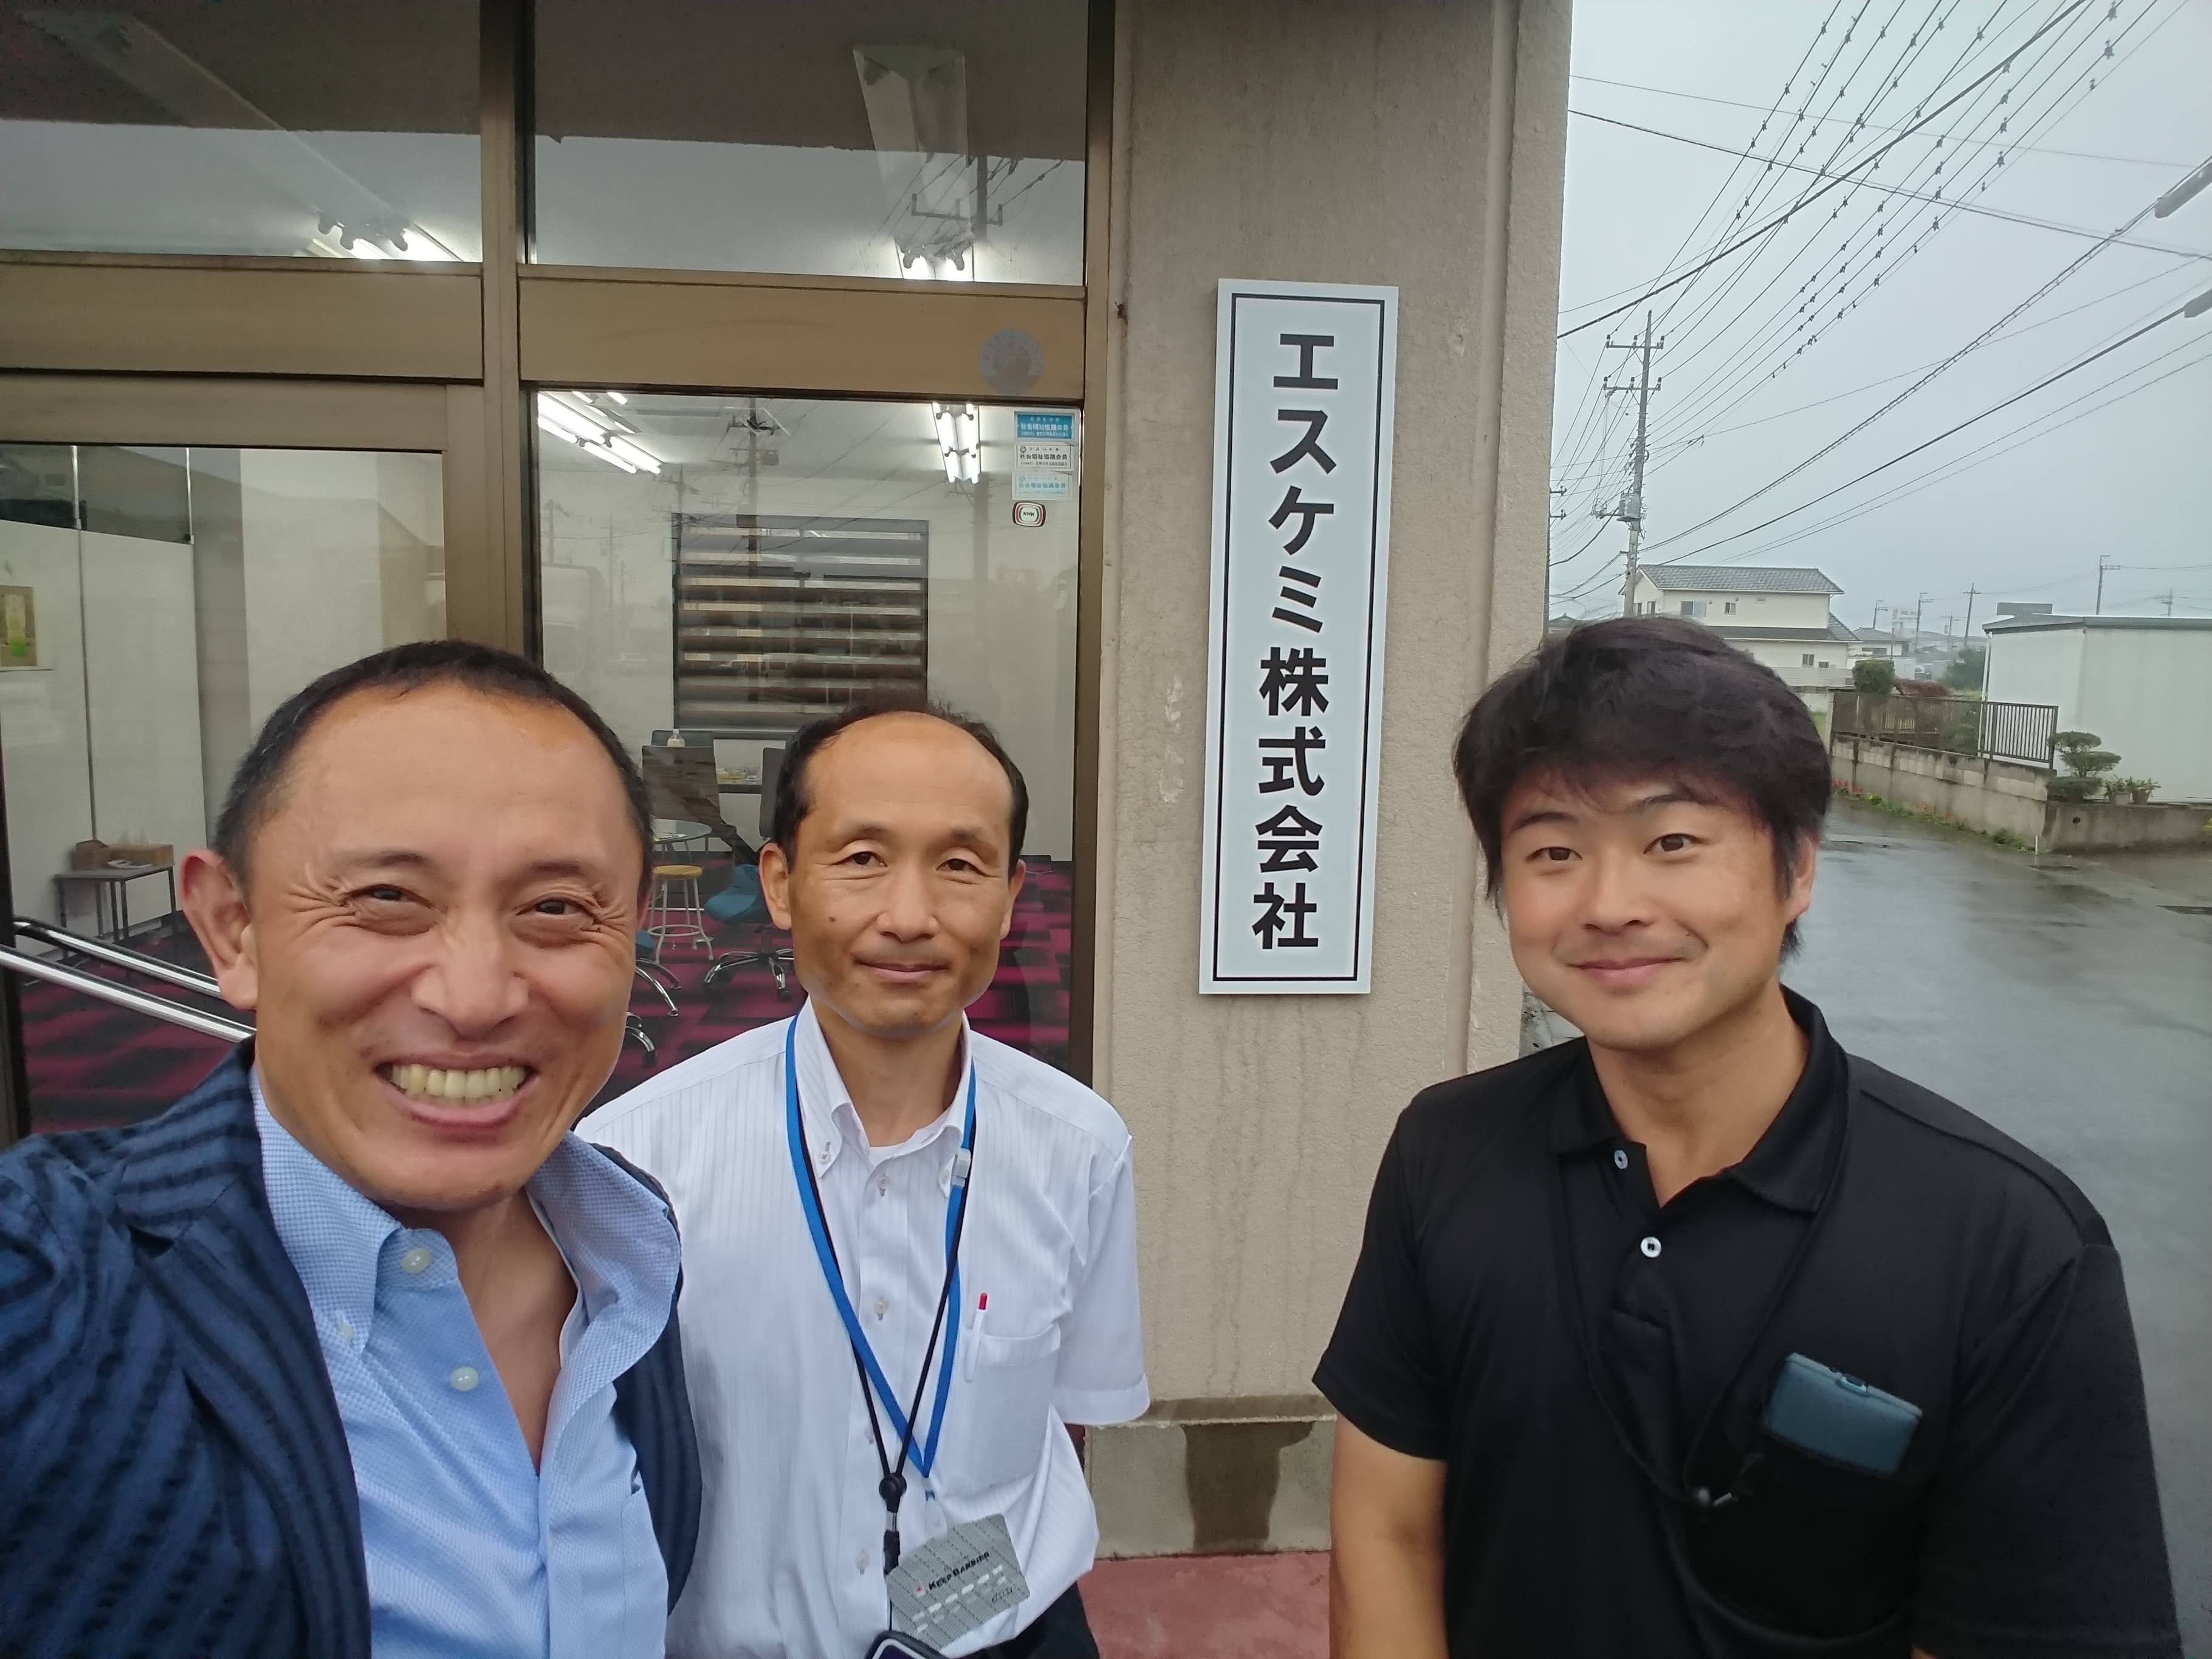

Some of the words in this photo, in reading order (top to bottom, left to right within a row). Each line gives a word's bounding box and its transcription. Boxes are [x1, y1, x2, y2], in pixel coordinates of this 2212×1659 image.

[1251, 332, 1338, 950] エスケミ株式会社
